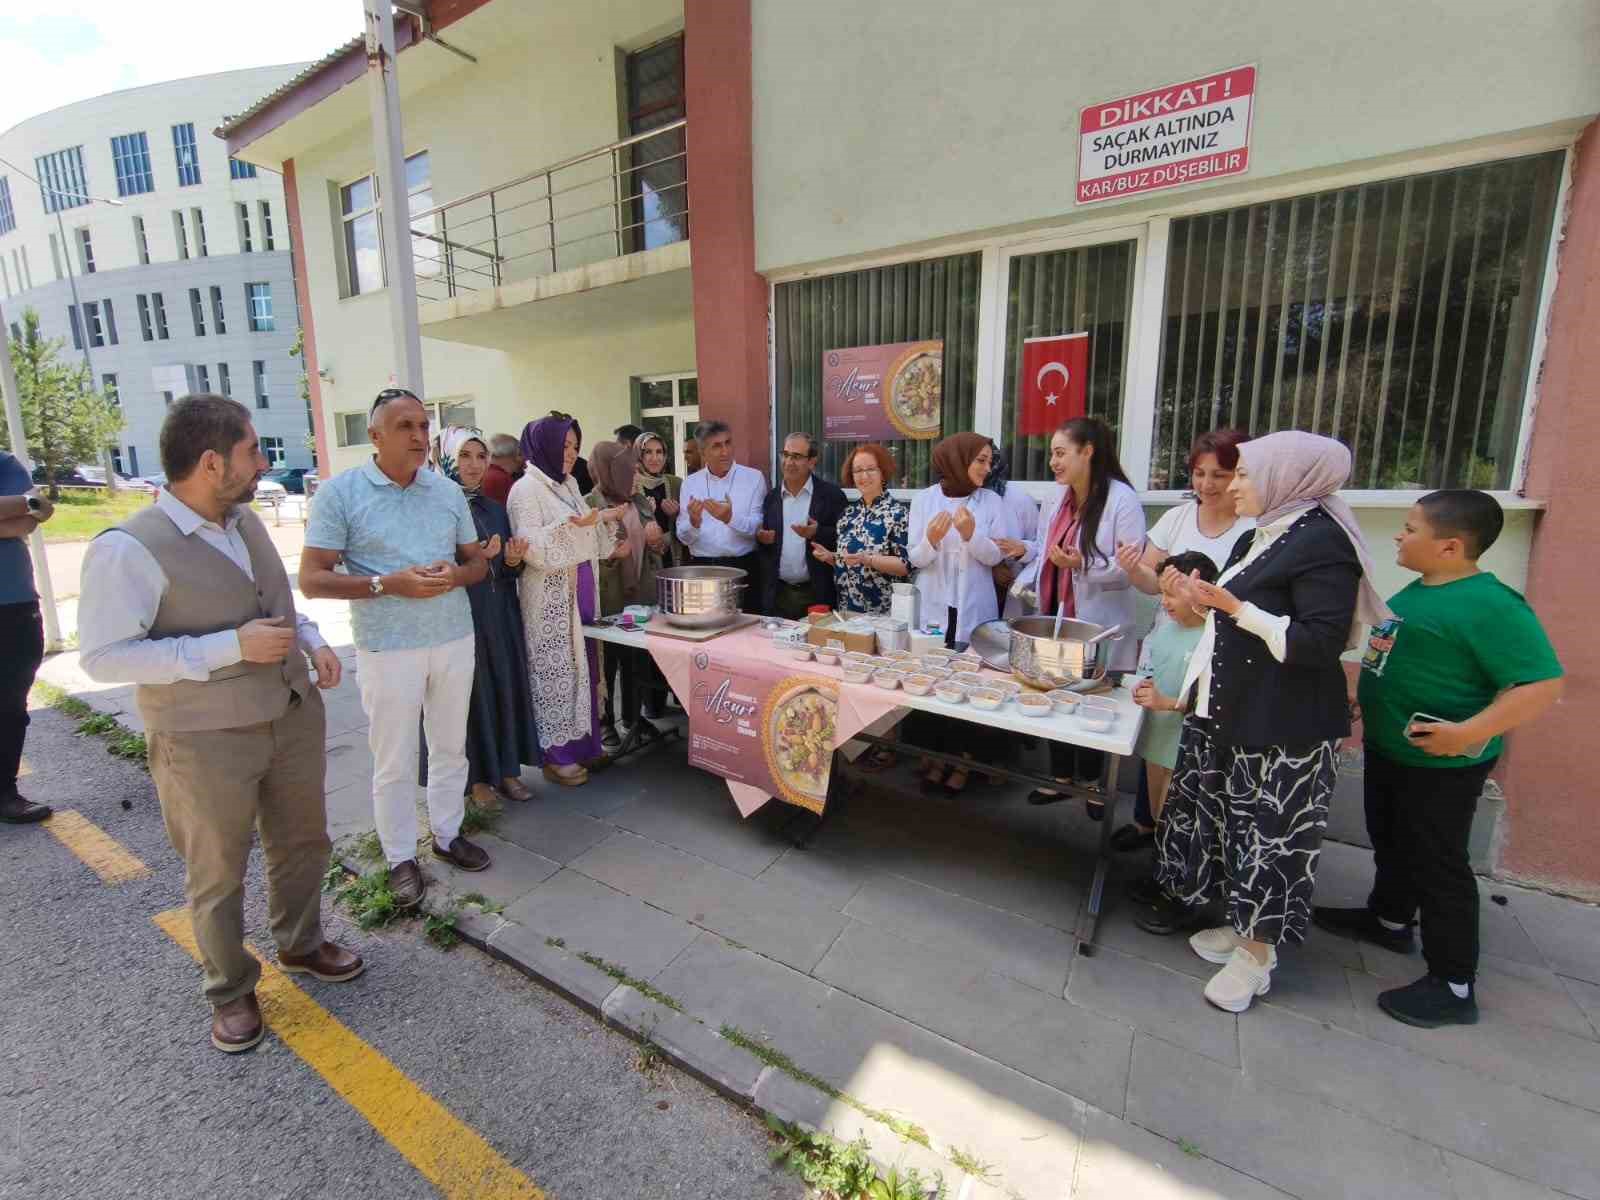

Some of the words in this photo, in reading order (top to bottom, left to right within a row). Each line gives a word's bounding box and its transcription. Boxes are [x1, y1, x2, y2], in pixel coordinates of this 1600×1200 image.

[1100, 81, 1217, 128] DİKKAT
[1223, 77, 1232, 97] !
[1092, 125, 1150, 153] SAÇAK
[1154, 106, 1234, 139] ALTINDA
[1104, 132, 1219, 170] DURMAYINIZ
[1080, 173, 1150, 198] KAR/BUZ
[1153, 153, 1241, 183] DÜŞEBİLİR
